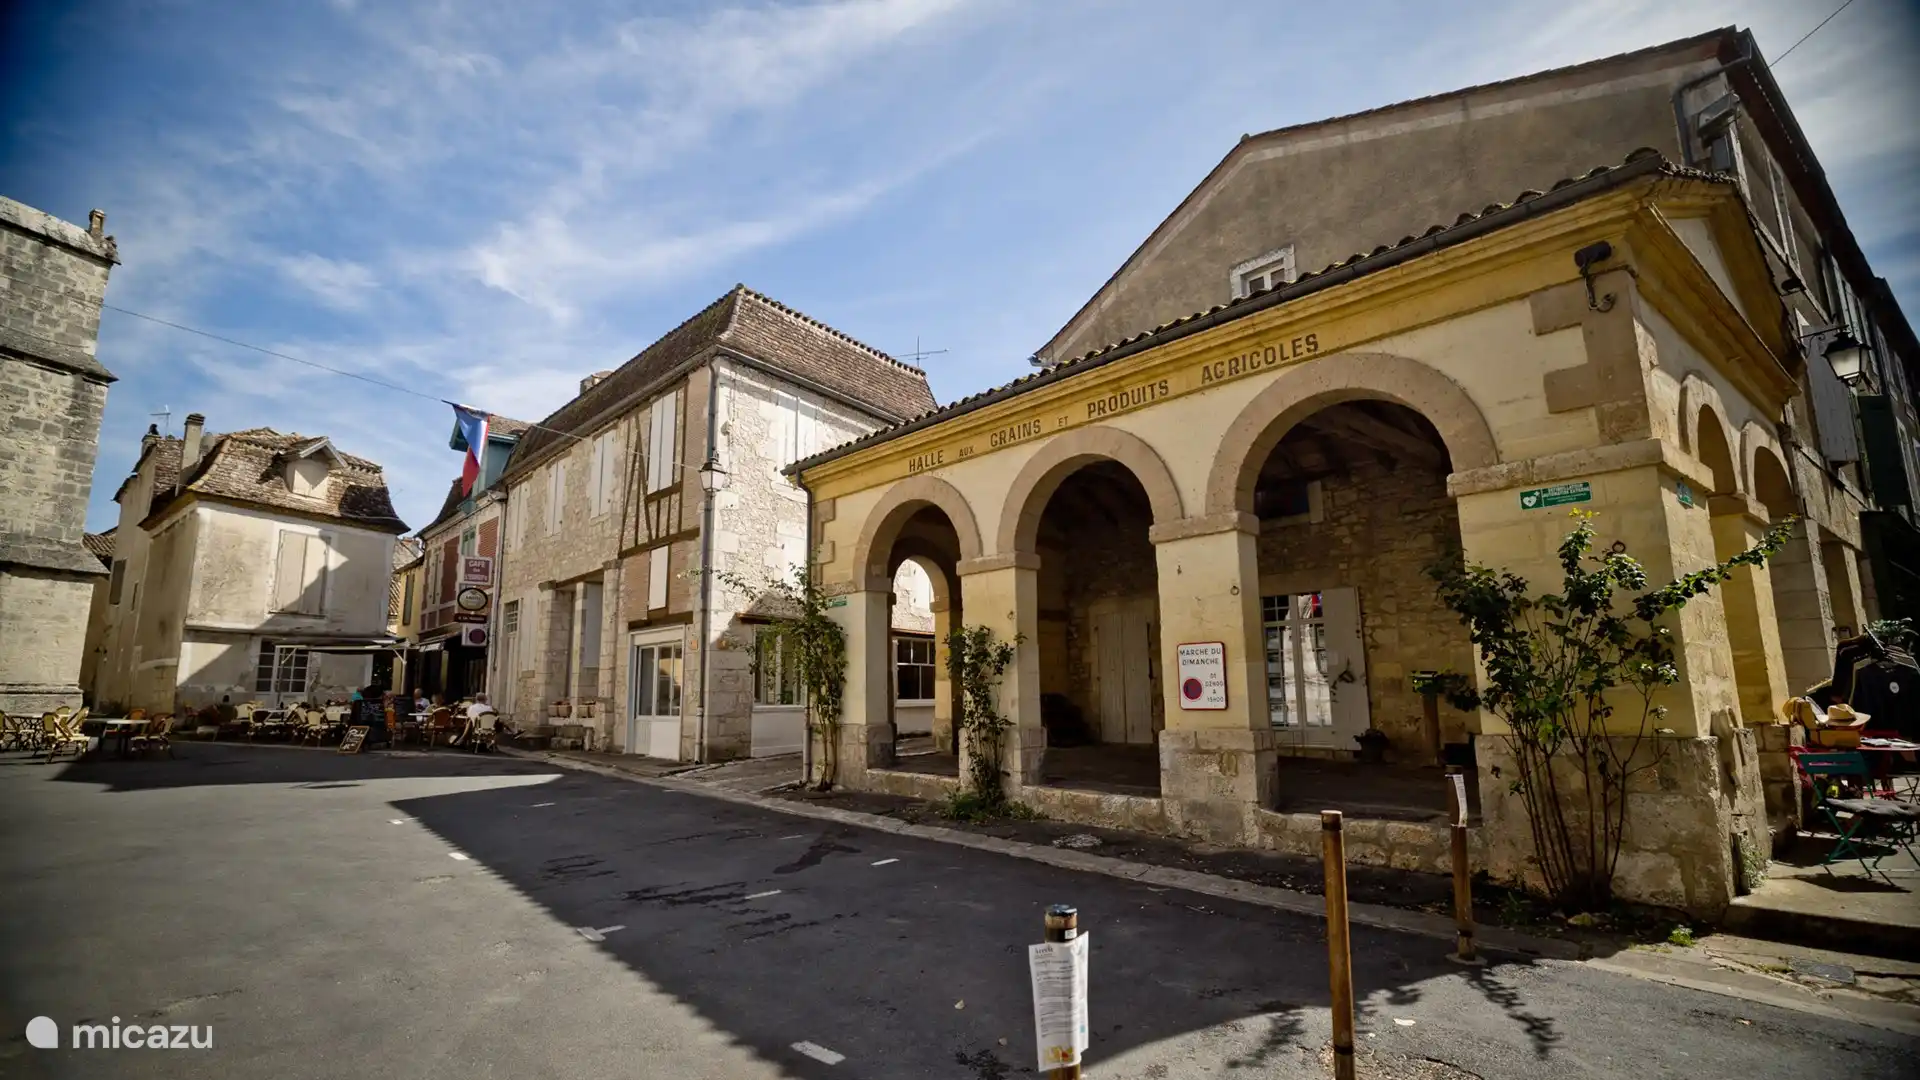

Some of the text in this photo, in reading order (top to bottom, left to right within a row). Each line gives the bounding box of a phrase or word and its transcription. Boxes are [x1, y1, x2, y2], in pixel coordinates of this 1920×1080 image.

[909, 333, 1319, 472] HALLE AUX GRAINS ET PRODUITS AGRICOLES
[1182, 658, 1219, 666] DIMANCHE
